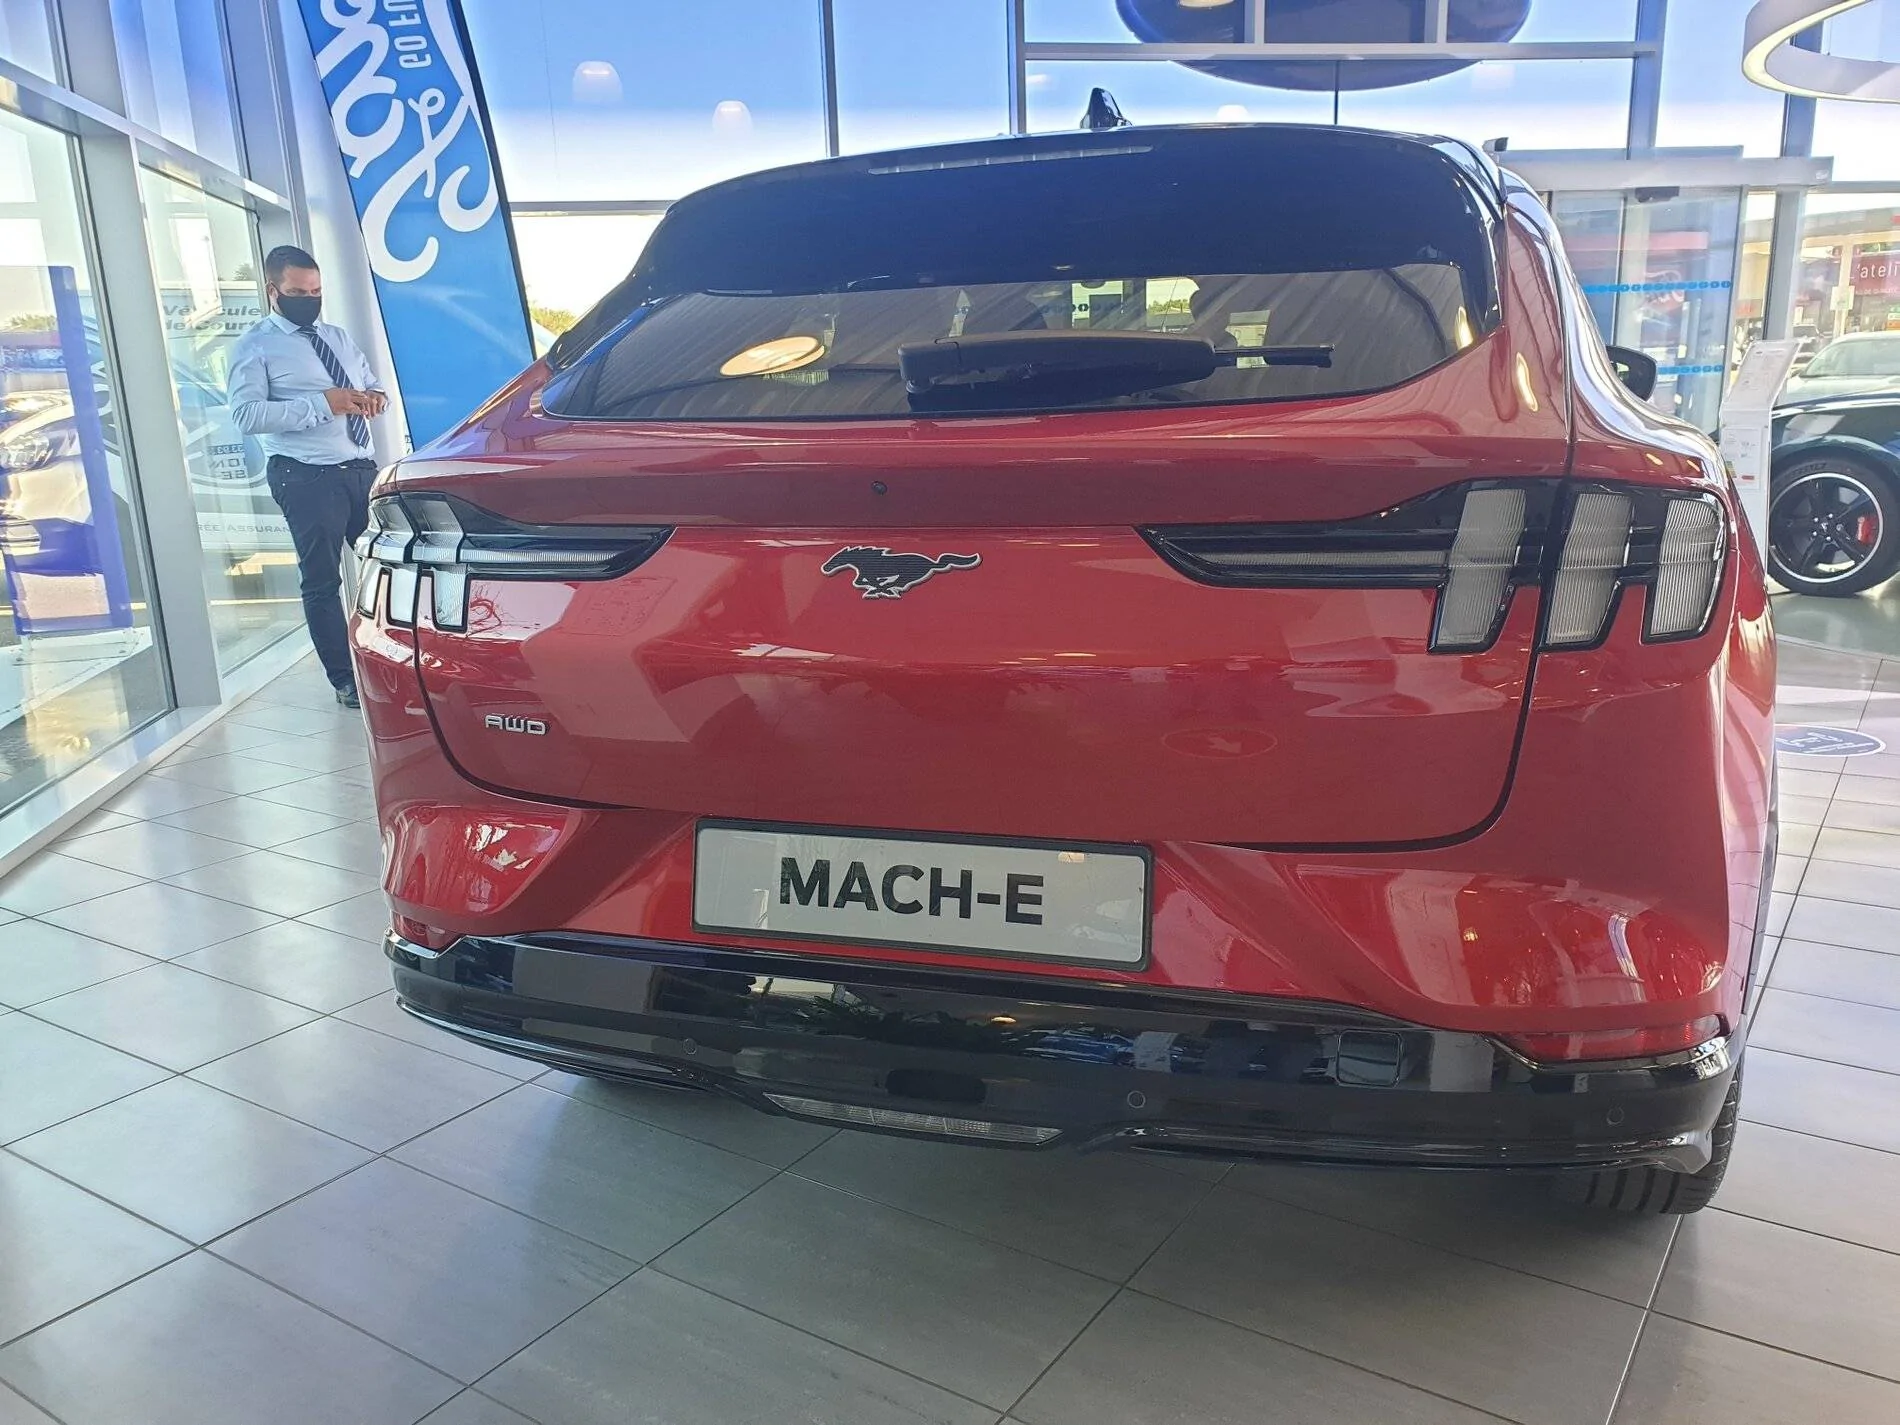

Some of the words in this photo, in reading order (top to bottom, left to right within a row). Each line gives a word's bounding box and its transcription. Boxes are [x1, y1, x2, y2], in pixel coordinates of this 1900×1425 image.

[163, 304, 262, 316] Vécule
[485, 714, 546, 735] AWD
[779, 857, 1044, 925] MACH-E
